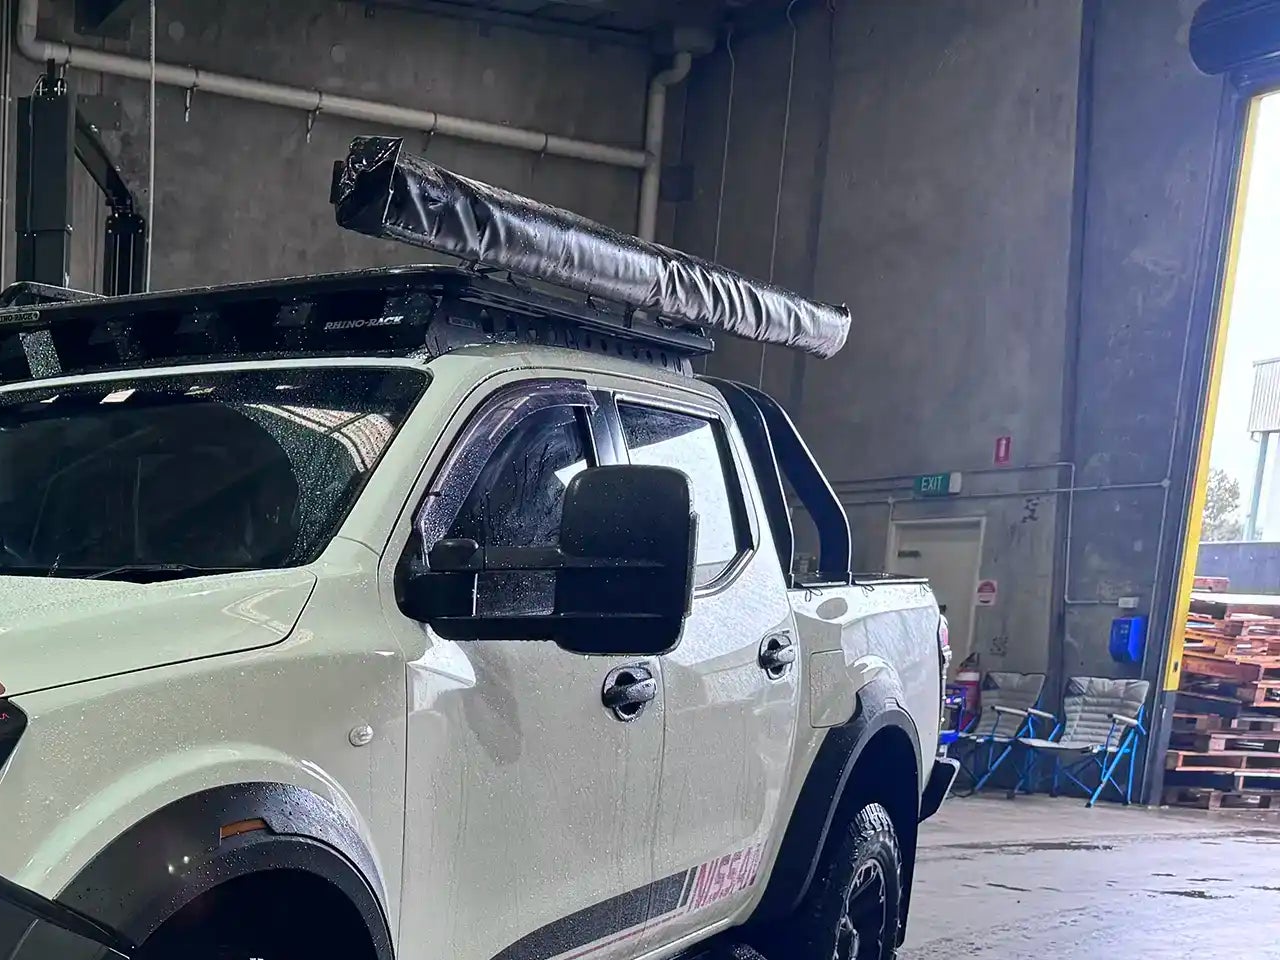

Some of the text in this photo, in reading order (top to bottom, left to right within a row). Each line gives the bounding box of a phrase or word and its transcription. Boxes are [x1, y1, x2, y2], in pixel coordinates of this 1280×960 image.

[324, 316, 404, 330] RHINO-RACK
[921, 476, 943, 491] EXIT
[692, 847, 759, 909] NISSAN
